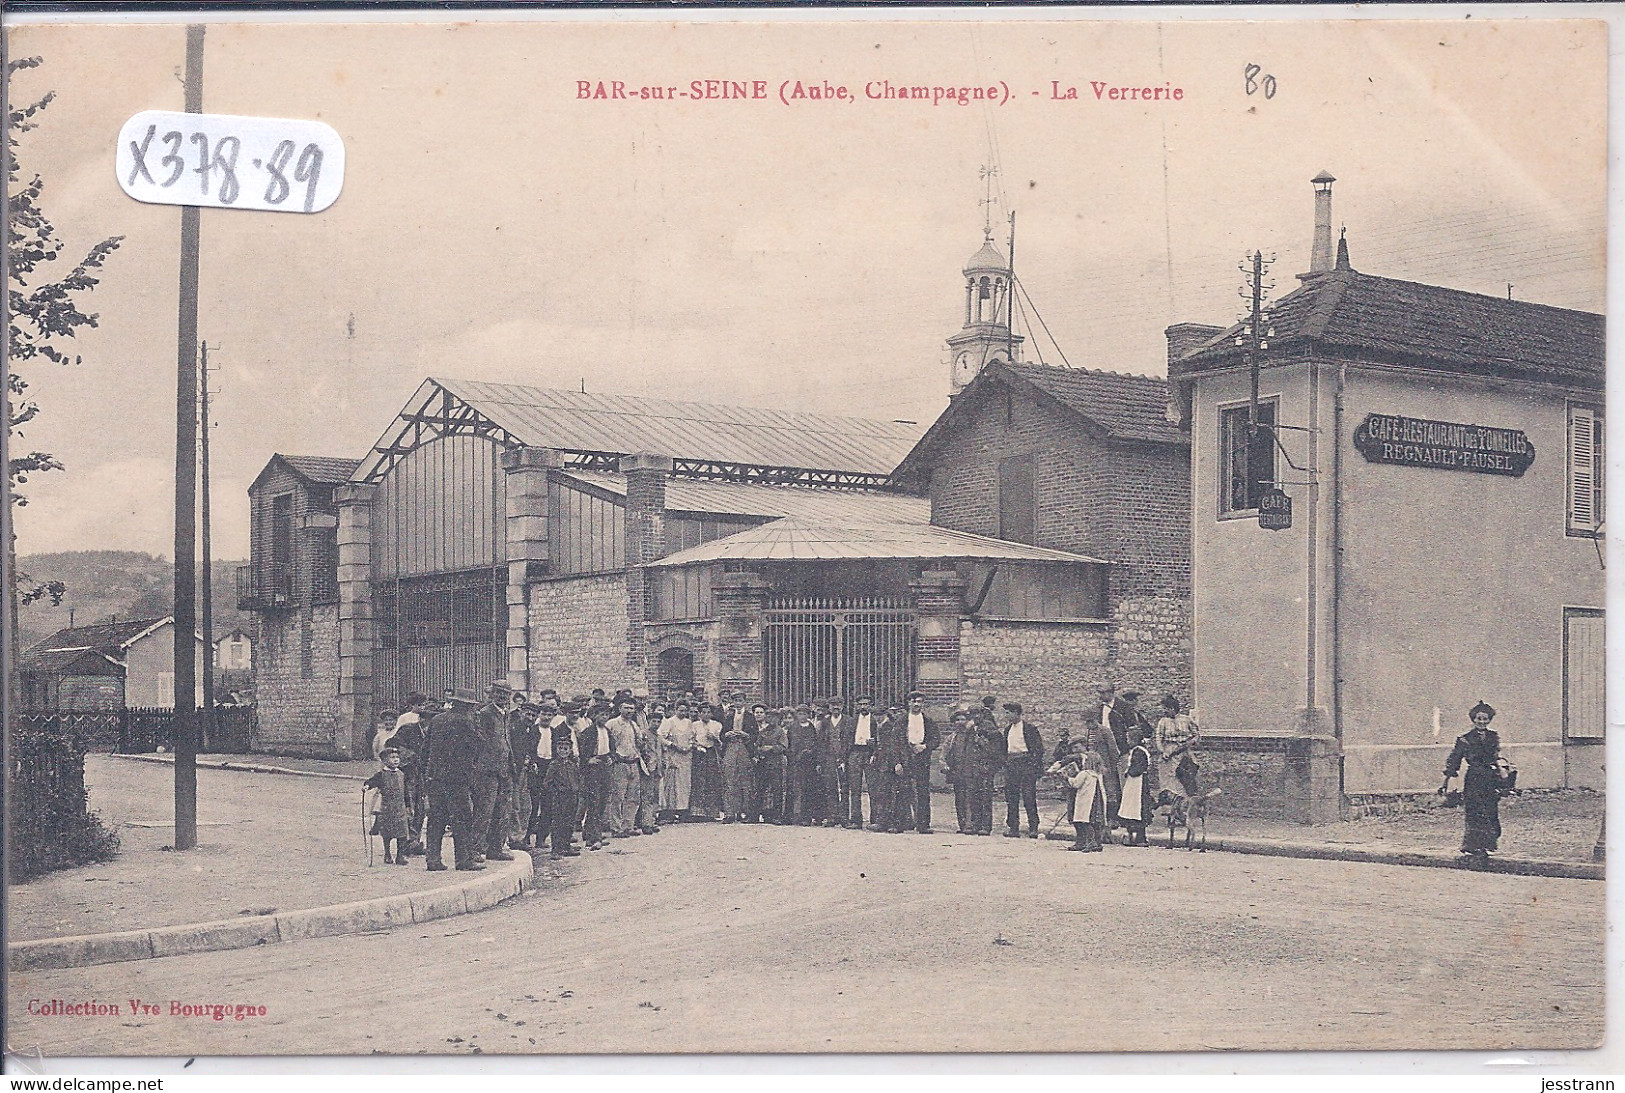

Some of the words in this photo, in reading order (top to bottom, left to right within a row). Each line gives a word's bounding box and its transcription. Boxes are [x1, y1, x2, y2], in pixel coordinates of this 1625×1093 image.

[576, 80, 768, 100] BAR-sur-SEINE
[779, 80, 855, 106] (Aube,
[865, 81, 1015, 106] Champagne).
[1051, 81, 1078, 100] La
[1091, 81, 1184, 101] Verrerie
[1245, 62, 1276, 99] 80
[28, 999, 119, 1017] Collection
[169, 1000, 267, 1021] Bourgogne
